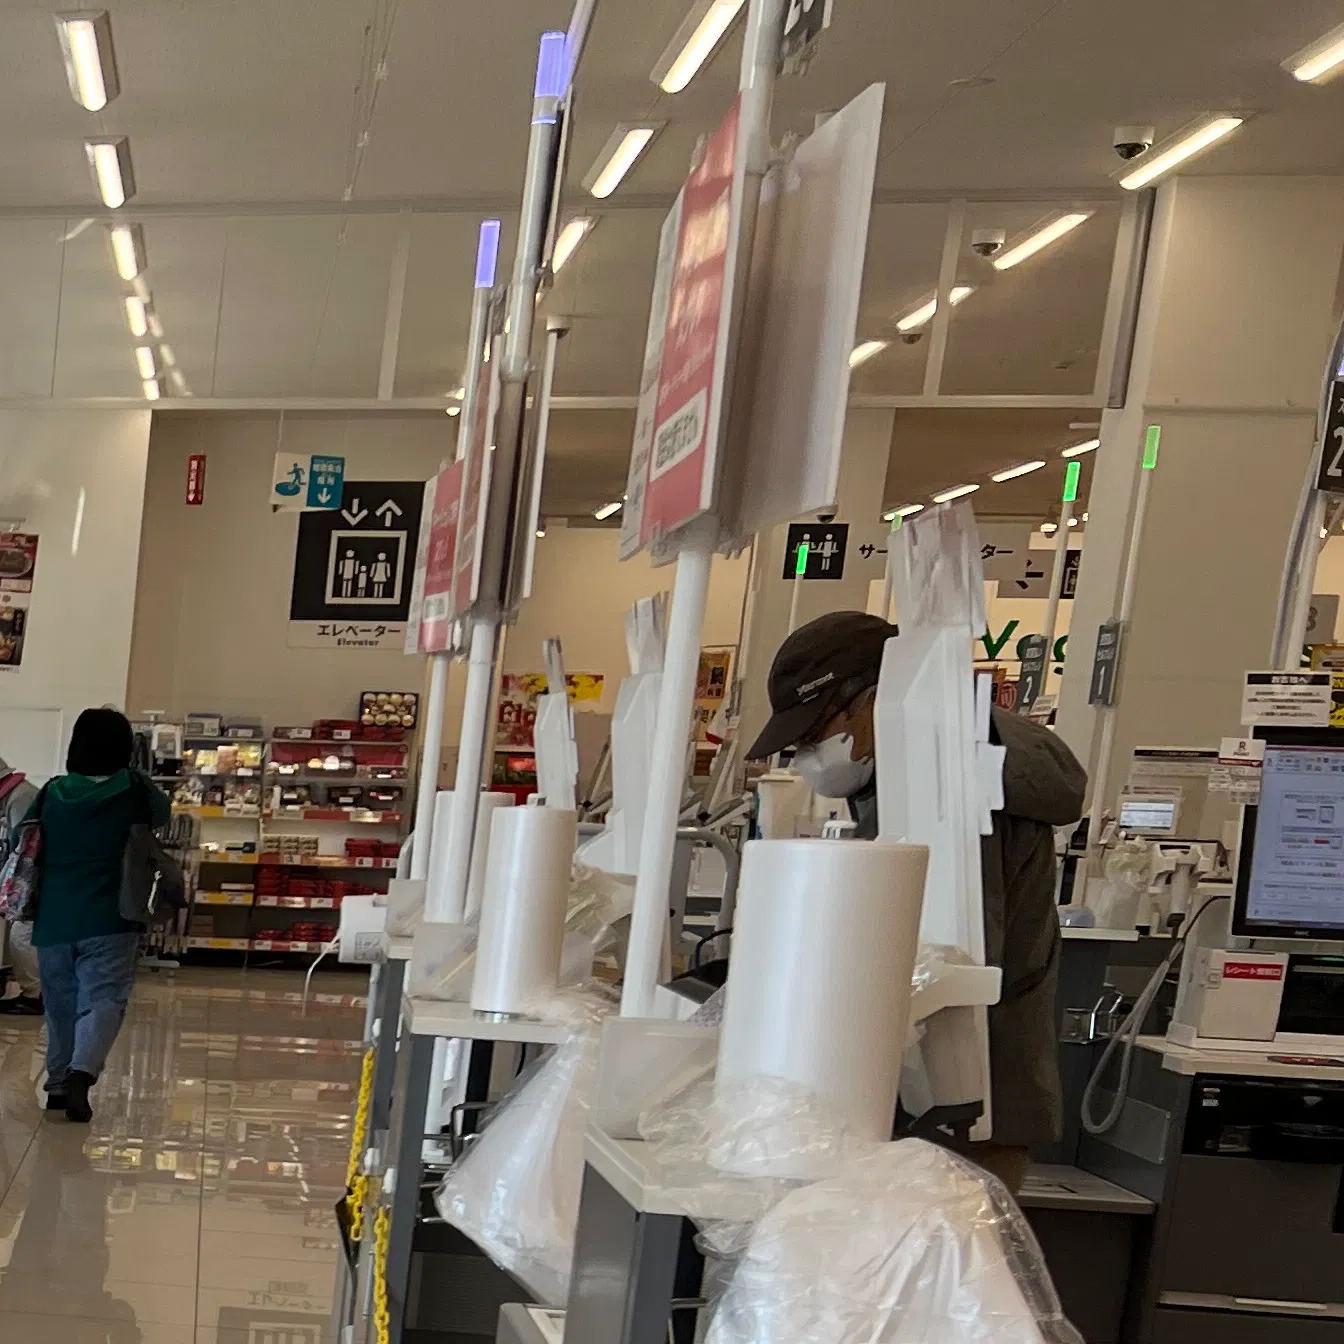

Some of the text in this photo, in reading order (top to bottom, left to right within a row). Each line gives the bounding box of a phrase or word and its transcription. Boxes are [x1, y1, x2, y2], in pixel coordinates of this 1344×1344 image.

[317, 623, 401, 637] エレベーター
